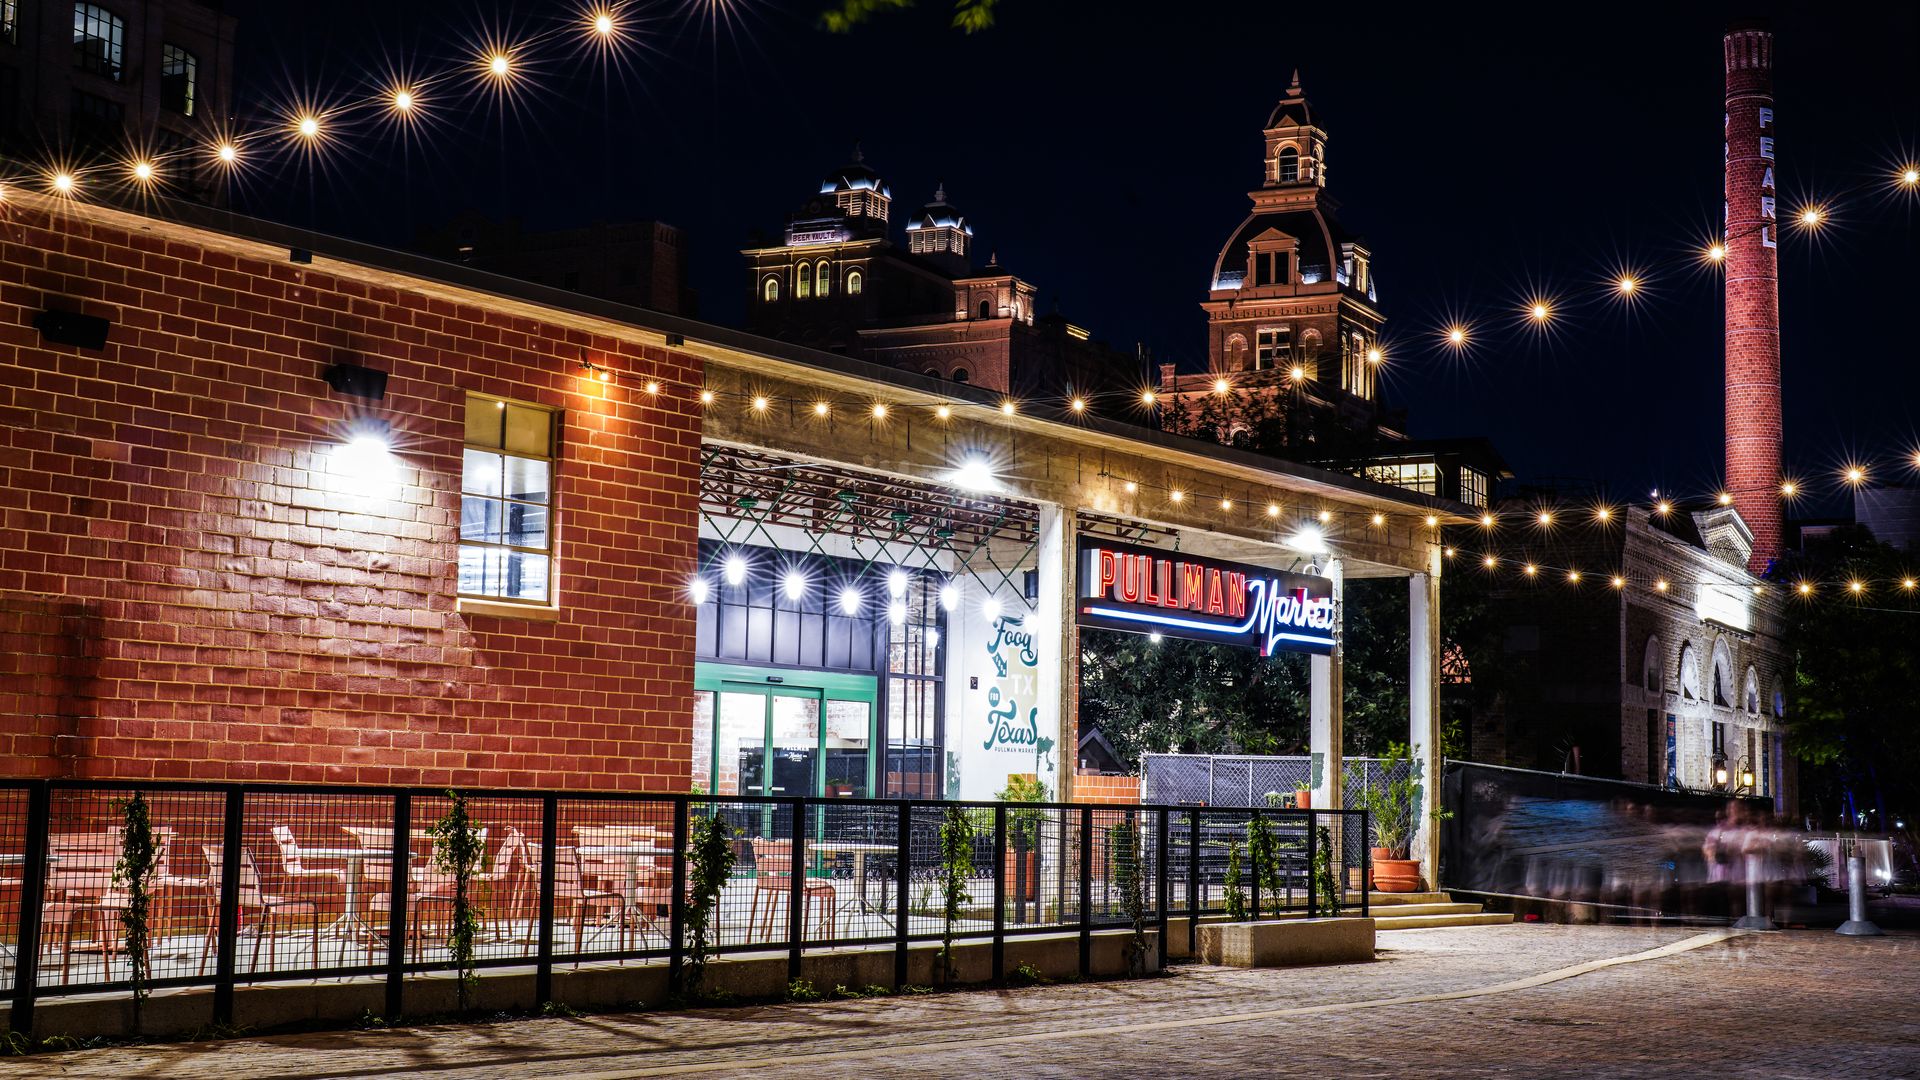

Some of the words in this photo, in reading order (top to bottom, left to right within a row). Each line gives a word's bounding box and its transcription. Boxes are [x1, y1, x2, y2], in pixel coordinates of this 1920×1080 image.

[1759, 107, 1777, 249] PEARL
[792, 234, 811, 242] BEER
[811, 231, 835, 240] VAULTS
[1099, 550, 1246, 618] PULLMAN
[1246, 578, 1333, 657] Market
[990, 692, 999, 700] FOR
[1010, 674, 1034, 695] TX
[983, 699, 1038, 750] Texas
